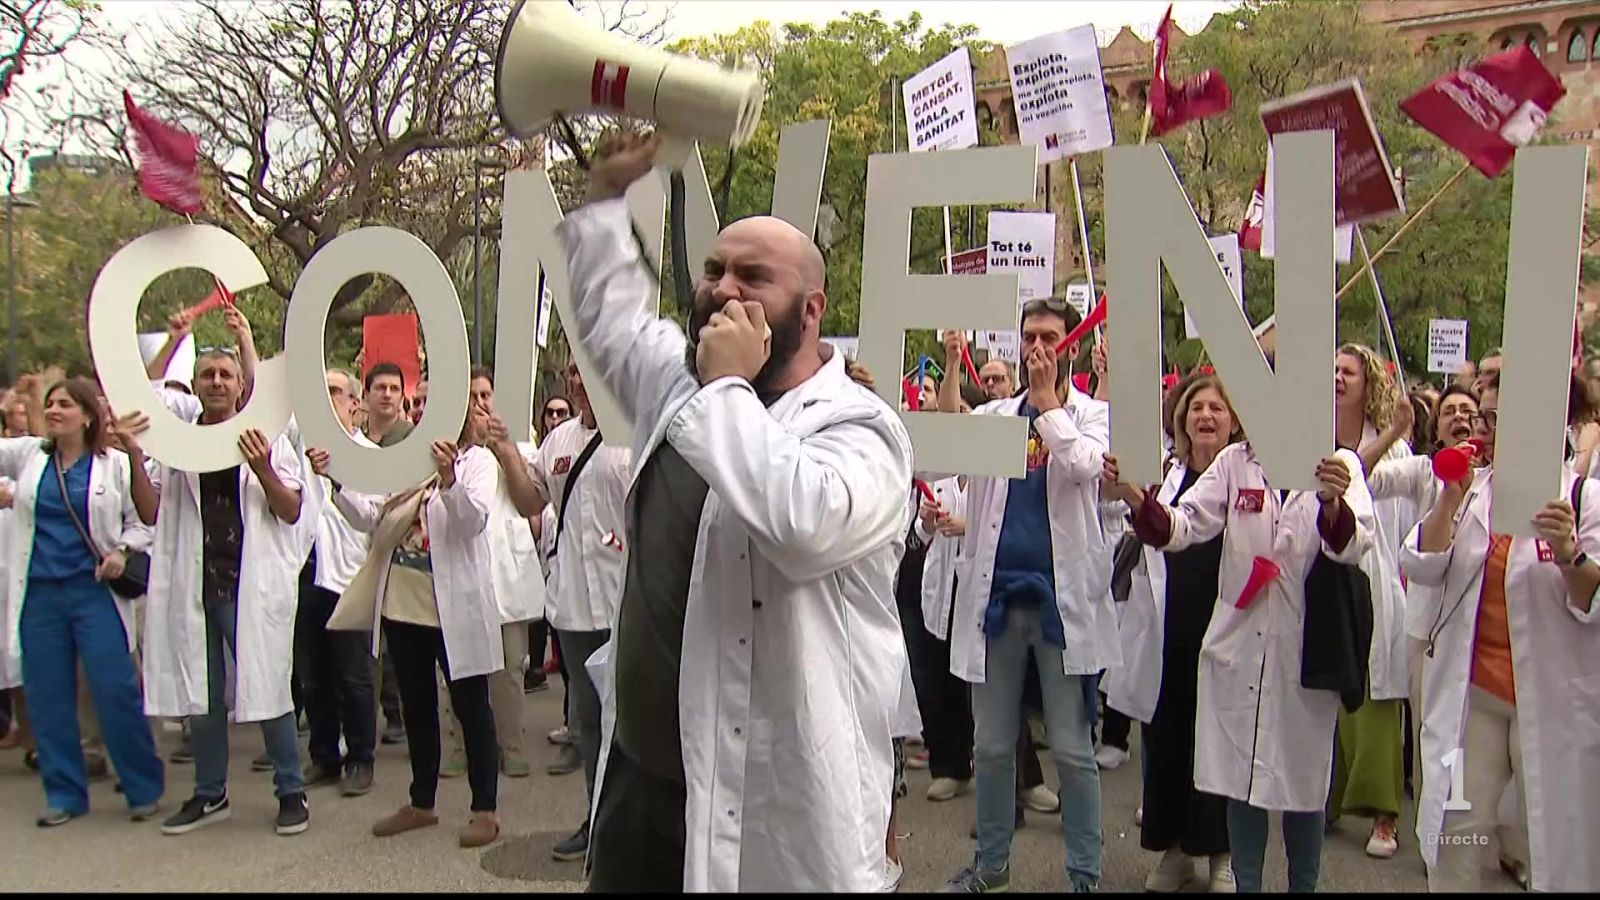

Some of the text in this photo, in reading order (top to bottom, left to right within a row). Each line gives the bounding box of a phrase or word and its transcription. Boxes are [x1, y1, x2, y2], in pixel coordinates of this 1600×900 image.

[1013, 53, 1068, 76] Explota,
[1015, 63, 1069, 87] explota,
[911, 71, 954, 103] METGE
[1018, 89, 1032, 99] me
[913, 82, 963, 117] CANSAT,
[1019, 88, 1069, 112] explota
[915, 106, 949, 132] MALA
[1021, 103, 1074, 124] mi vocación
[916, 110, 966, 147] SANITAT
[991, 241, 1032, 252] Tot té
[991, 256, 1046, 267] un límit
